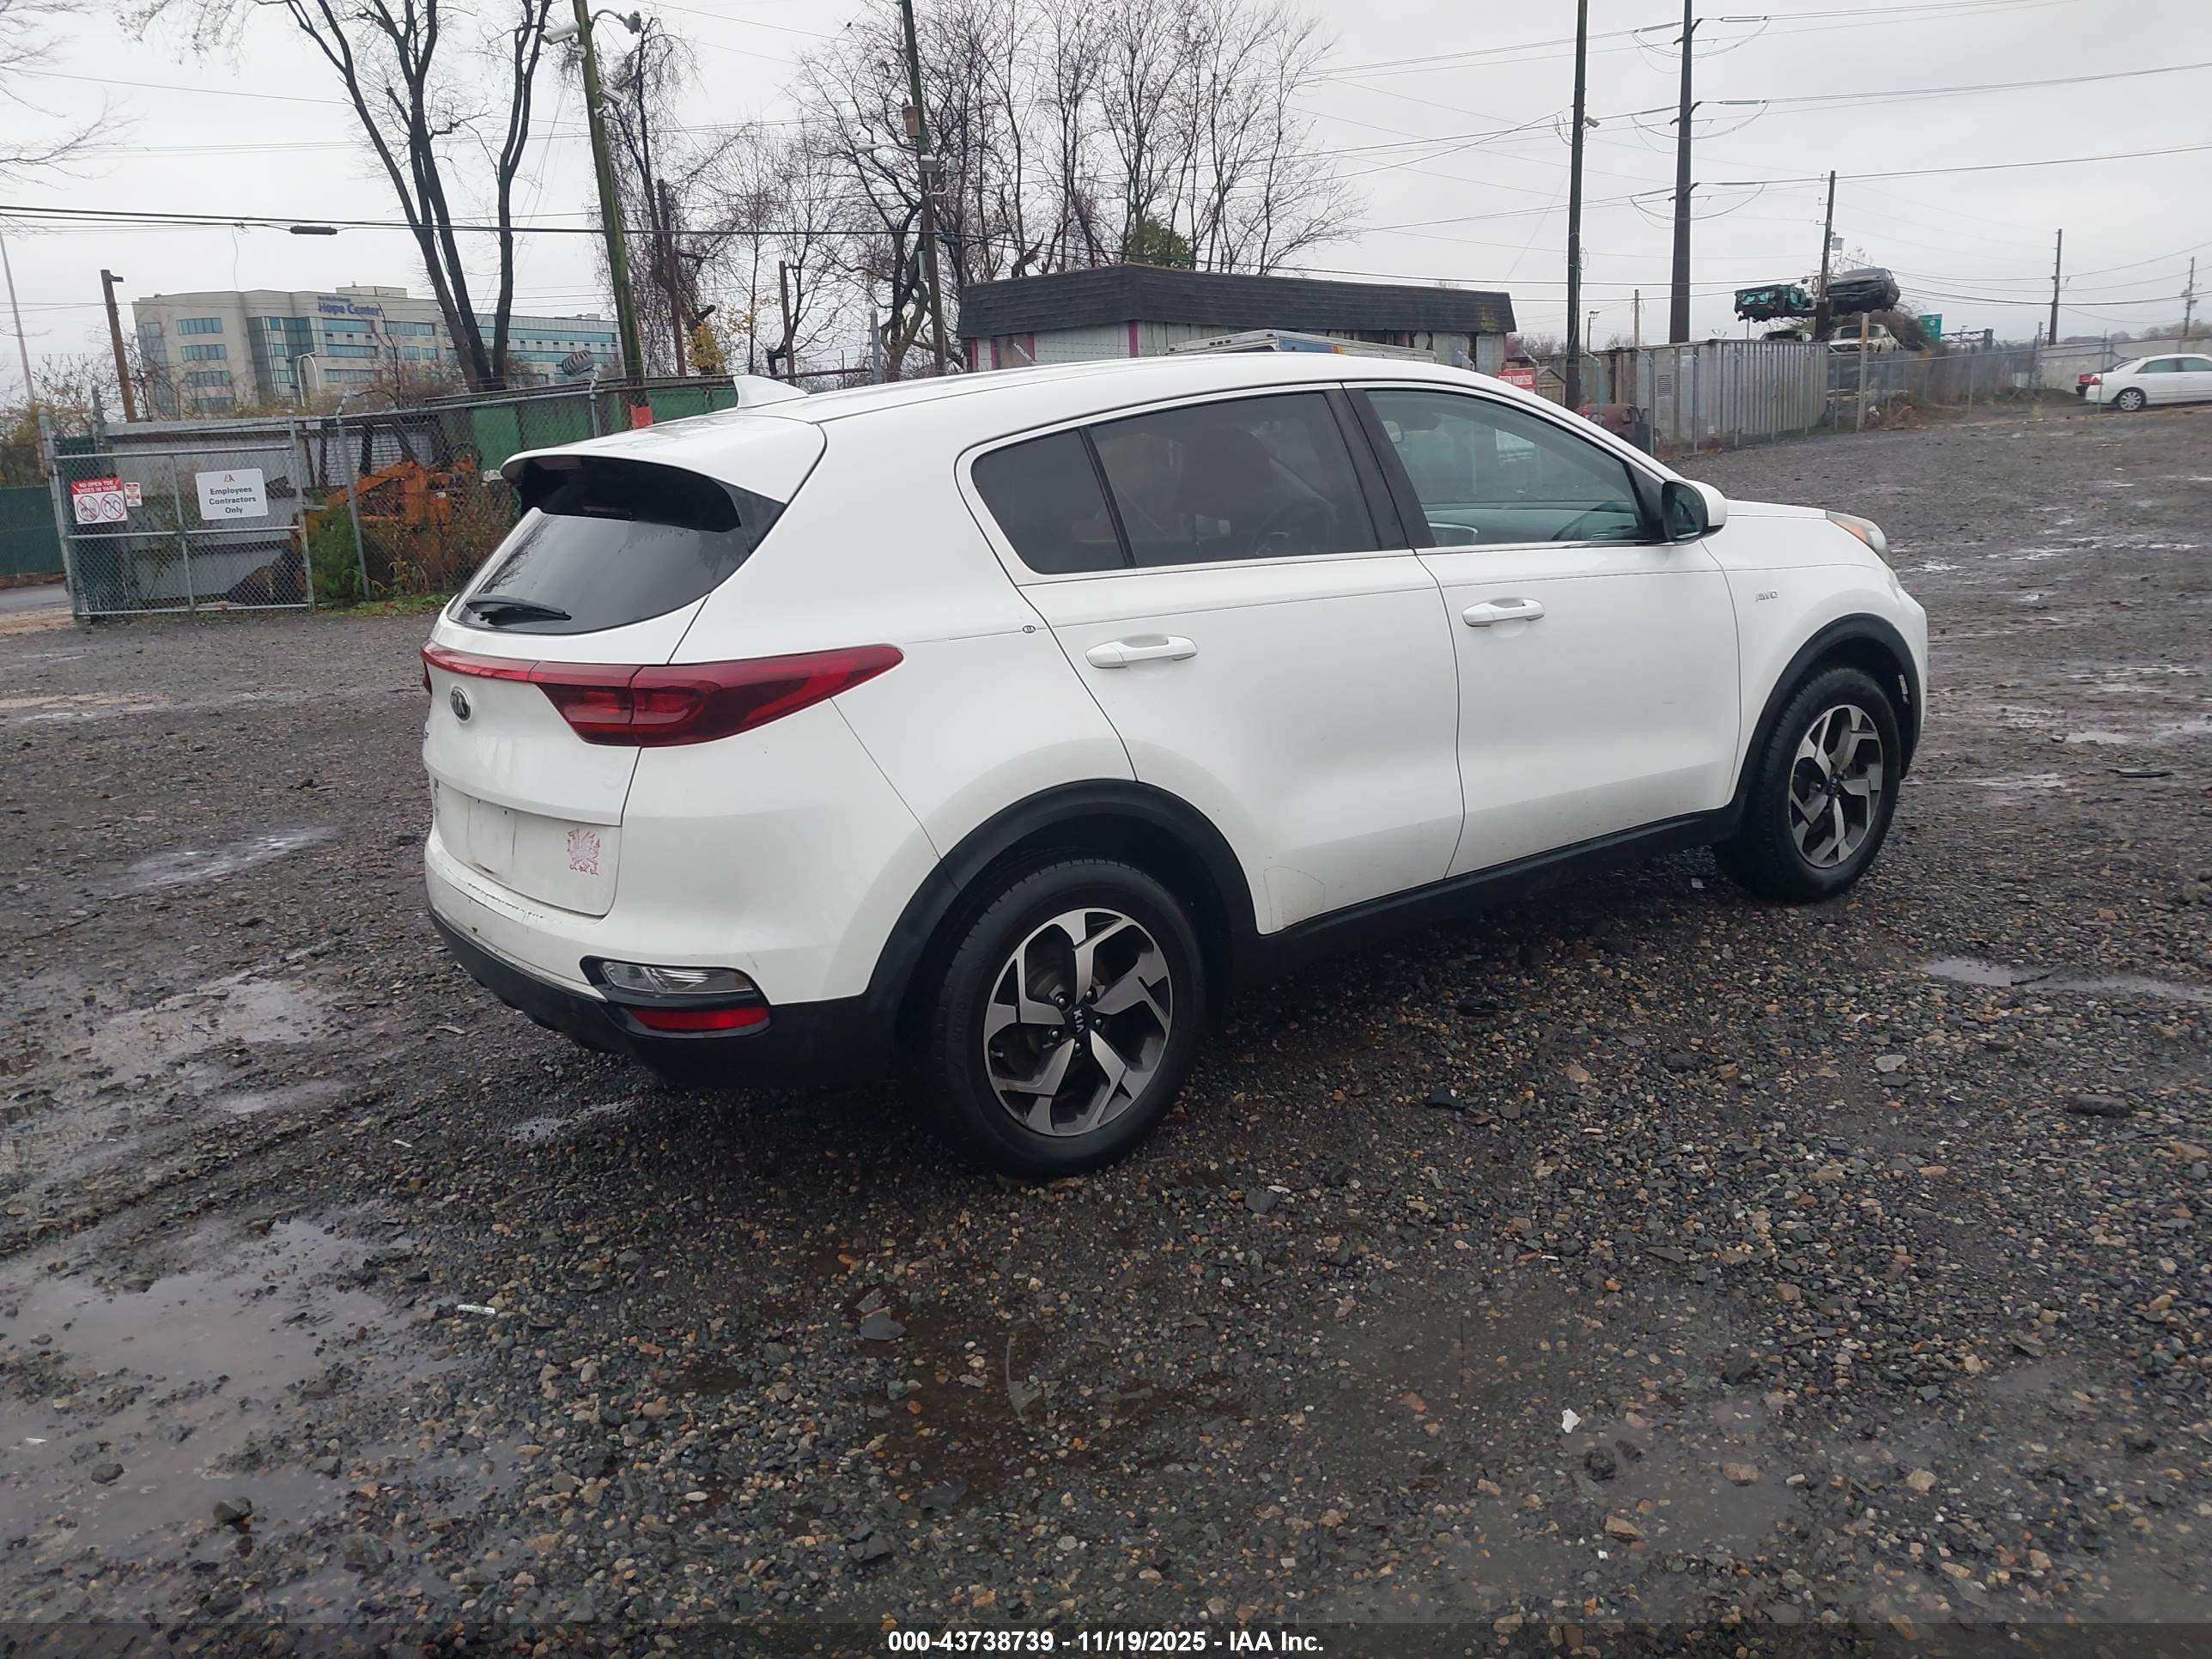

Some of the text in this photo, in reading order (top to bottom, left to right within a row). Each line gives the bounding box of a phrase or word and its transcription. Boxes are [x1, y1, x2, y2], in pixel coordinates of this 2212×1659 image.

[317, 301, 345, 315] Hope
[210, 487, 252, 495] Employees
[209, 496, 257, 505] Contractors
[1073, 1009, 1085, 1033] KIA
